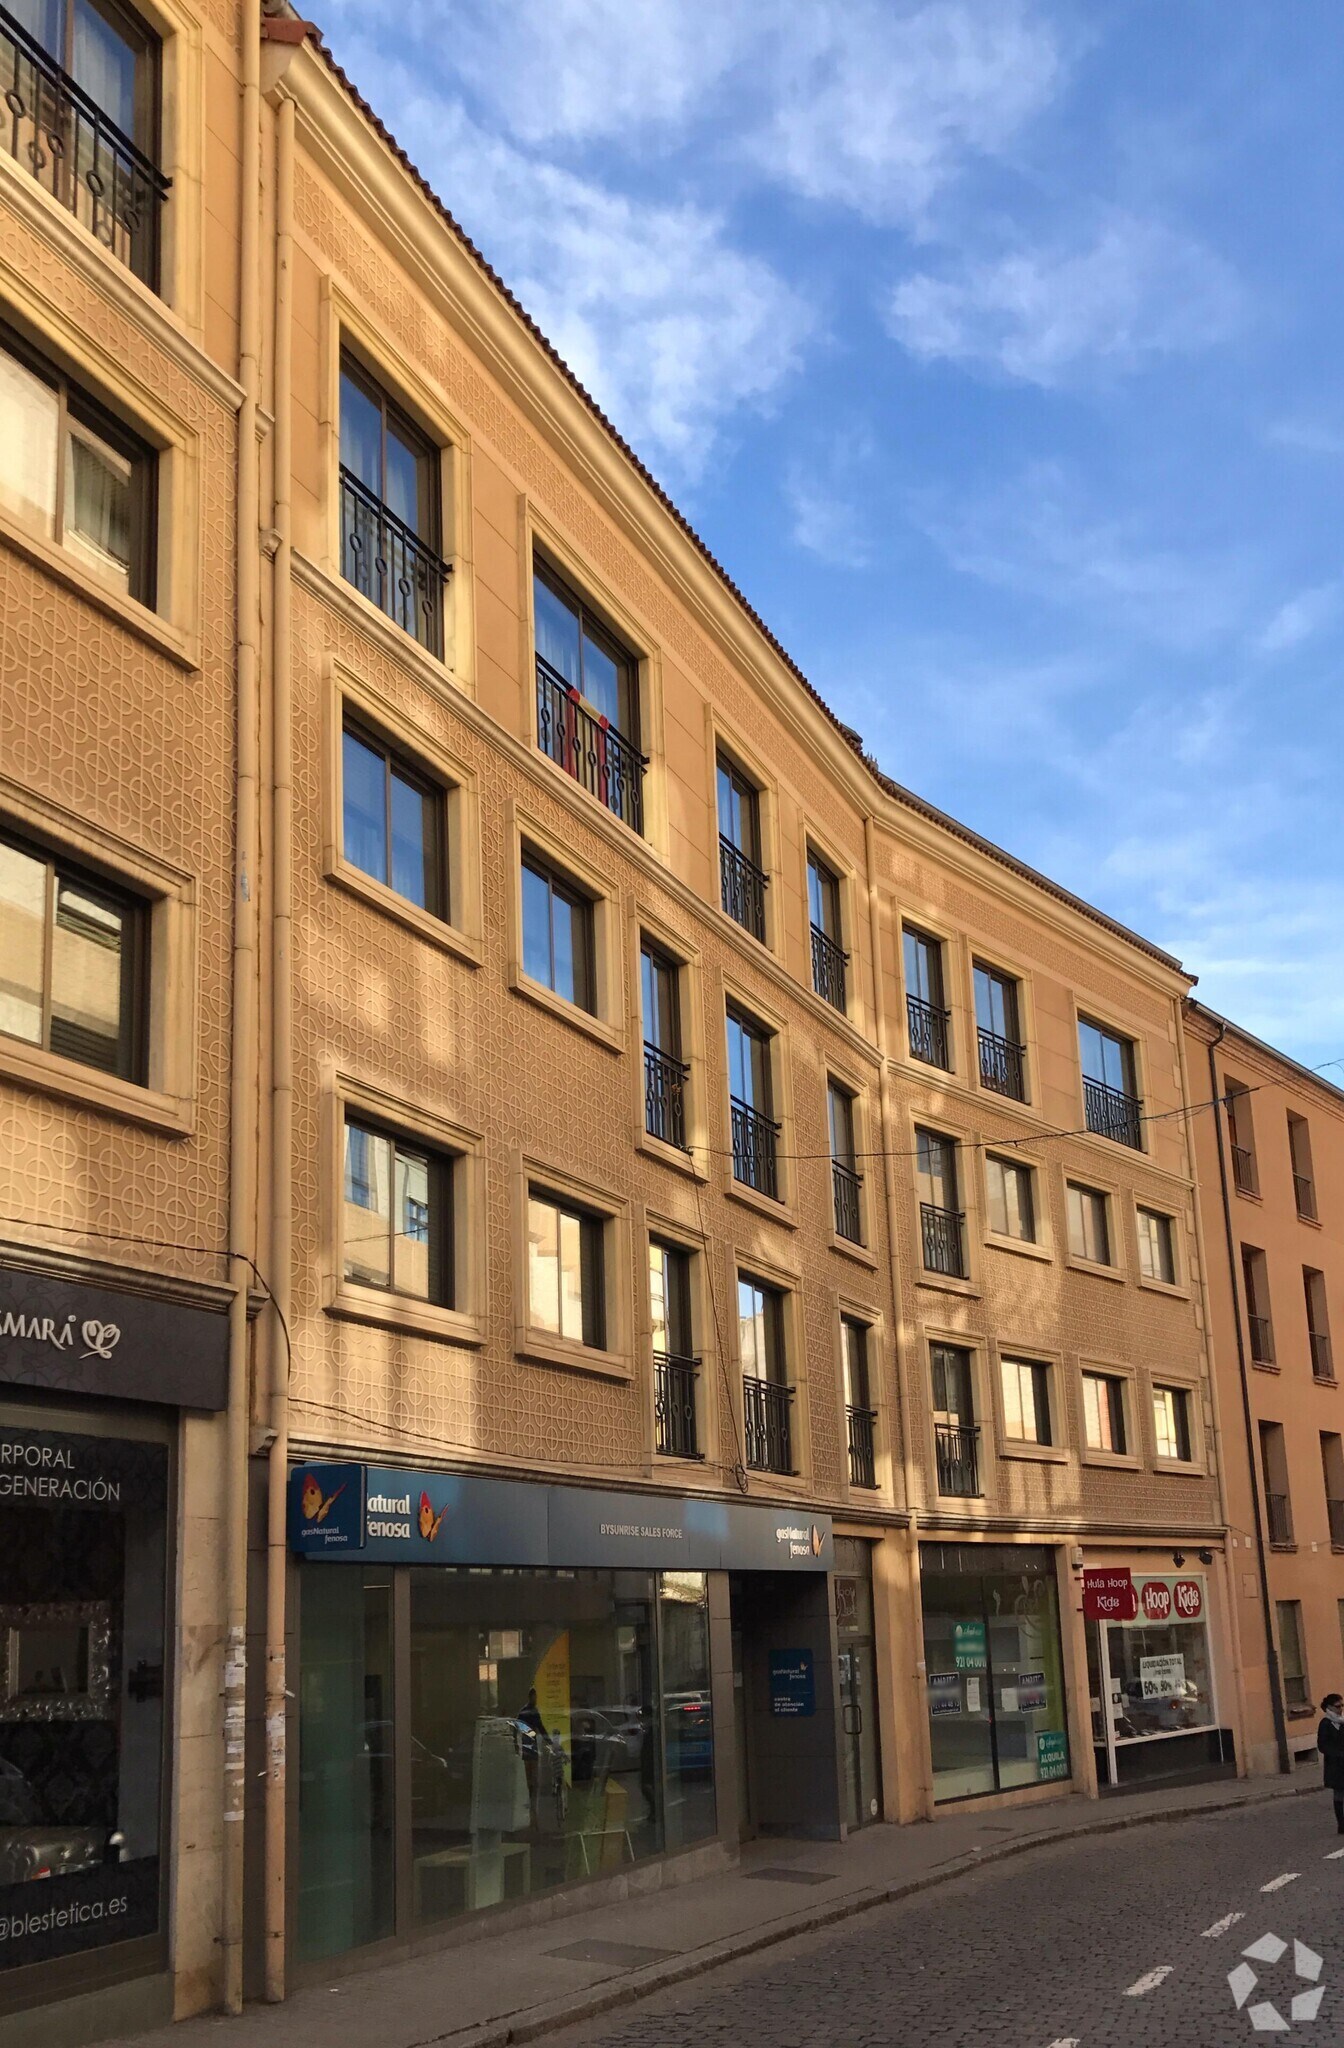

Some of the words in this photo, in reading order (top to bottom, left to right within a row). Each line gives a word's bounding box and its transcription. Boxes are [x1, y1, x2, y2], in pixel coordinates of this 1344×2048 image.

[1, 1444, 75, 1469] RPORAL
[0, 1474, 120, 1501] GENERACIÓN
[367, 1493, 411, 1515] atural
[301, 1526, 340, 1538] gasNatural
[324, 1534, 348, 1545] fenosa
[600, 1523, 640, 1537] BYSUNRISE
[640, 1526, 661, 1538] SALES
[662, 1527, 683, 1539] FORCE
[790, 1541, 810, 1559] fenosa
[1107, 1577, 1128, 1589] Hoop
[1097, 1595, 1120, 1611] Kids
[1145, 1588, 1170, 1614] Hoop
[1177, 1585, 1200, 1615] Kids
